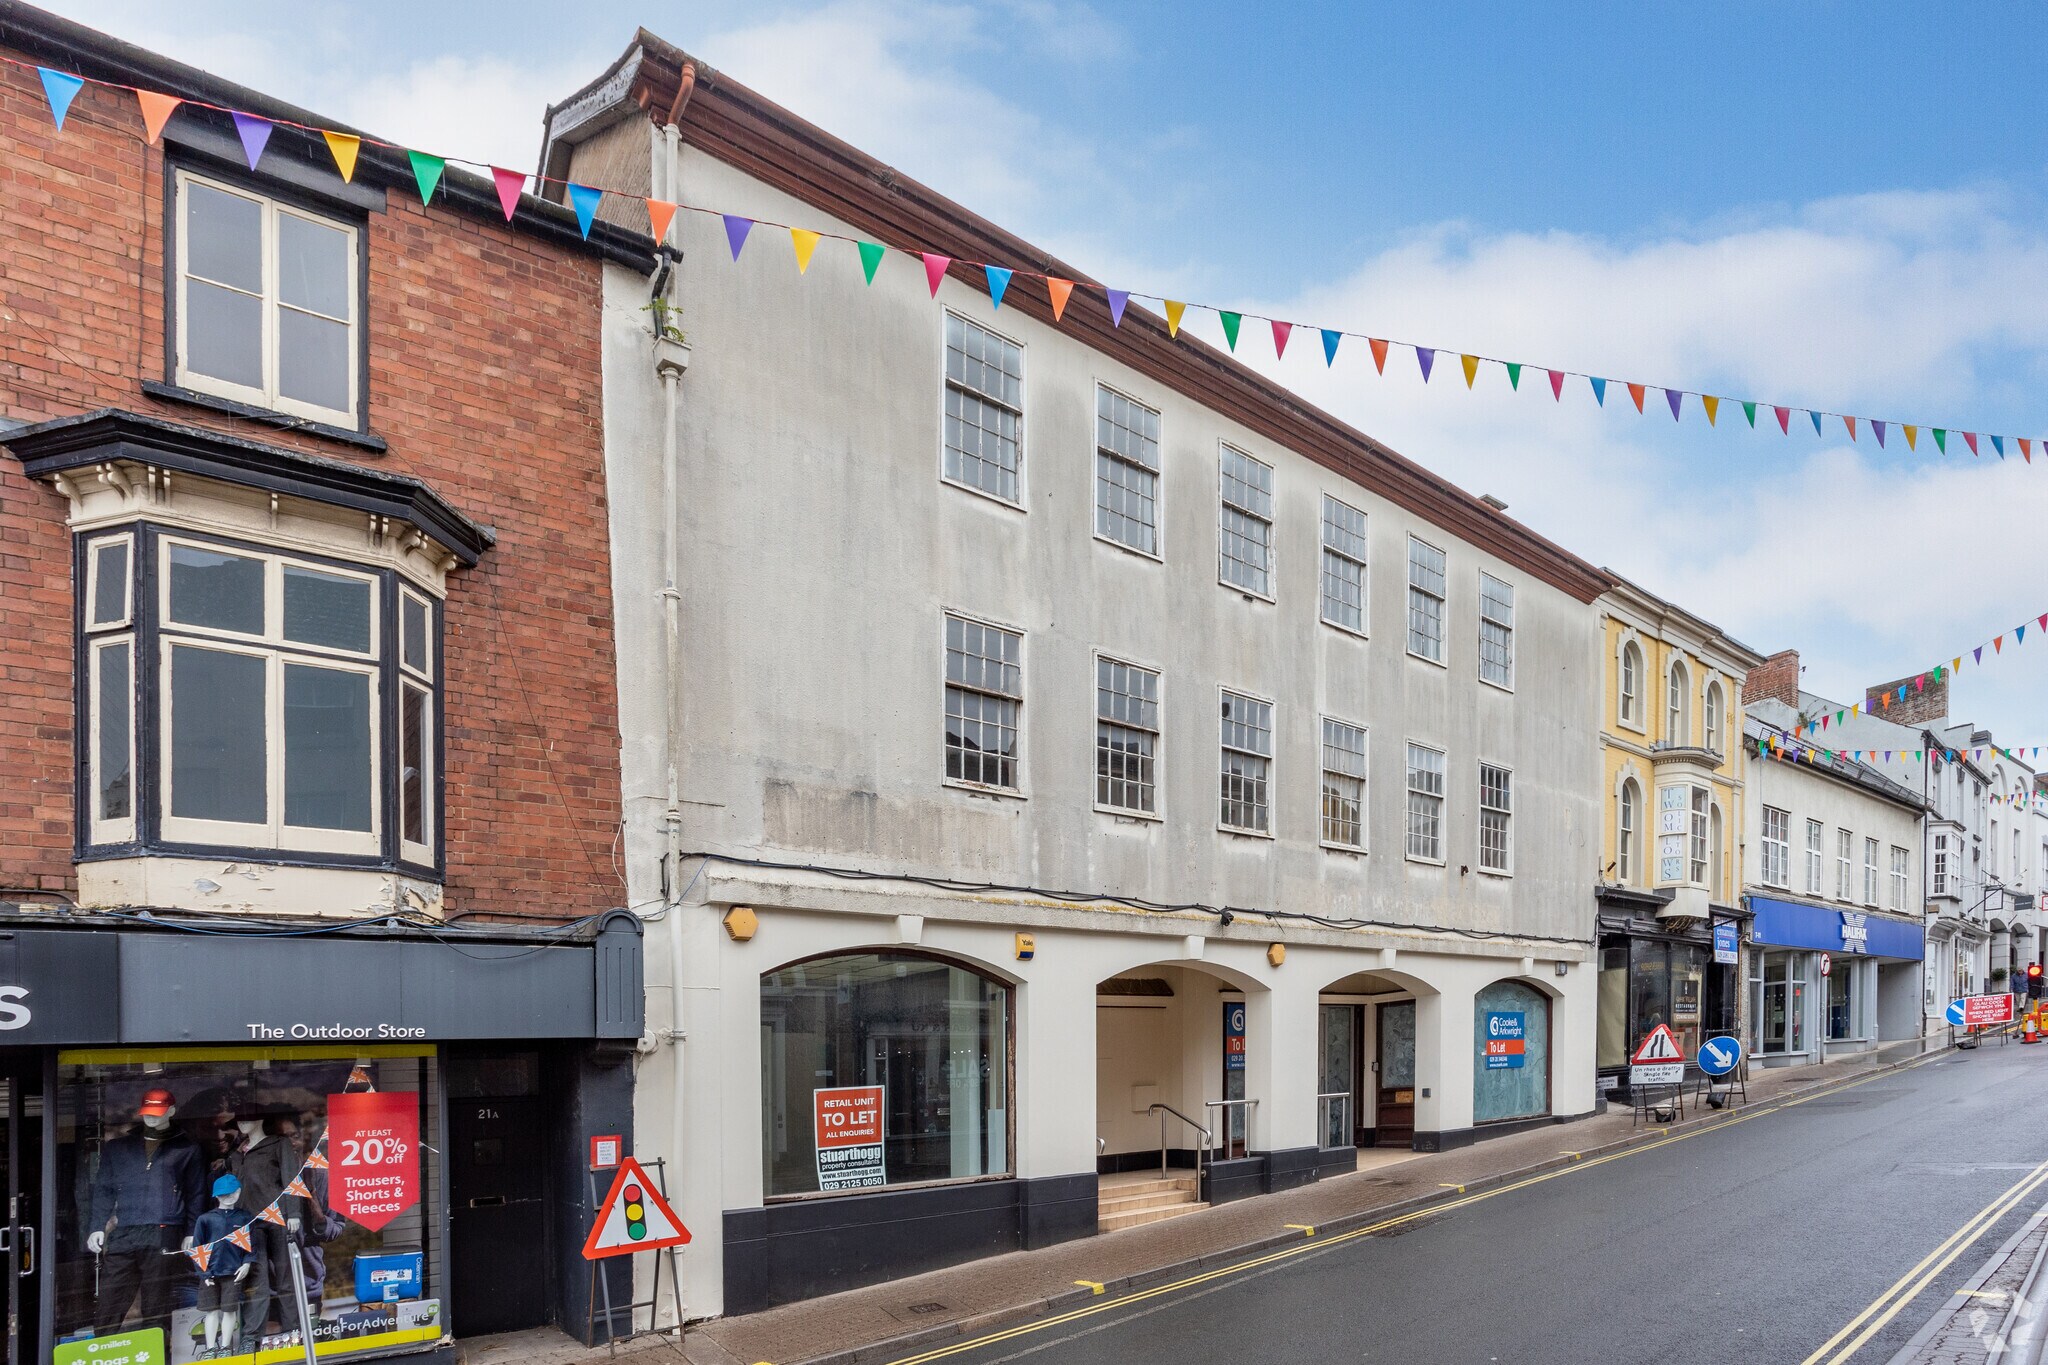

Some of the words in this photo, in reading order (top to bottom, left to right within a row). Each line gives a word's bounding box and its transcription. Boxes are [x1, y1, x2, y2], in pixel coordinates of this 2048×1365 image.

[1842, 924, 1867, 940] HALIFAX
[247, 1023, 285, 1039] The
[290, 1022, 373, 1038] Outdoor
[378, 1023, 426, 1038] Store
[1232, 1038, 1241, 1051] To
[1490, 1041, 1497, 1053] To
[1497, 1041, 1506, 1053] Let
[824, 1099, 853, 1108] RETAIL
[854, 1097, 875, 1106] UNIT
[822, 1112, 846, 1127] TO
[850, 1110, 877, 1125] LET
[355, 1130, 366, 1138] AT
[367, 1129, 392, 1137] LEAST
[840, 1128, 874, 1138] ENQUIRIES
[341, 1138, 408, 1166] 20%
[385, 1153, 404, 1164] off
[820, 1146, 881, 1163] stuarthogg
[822, 1161, 847, 1171] property
[847, 1159, 881, 1168] consultants
[822, 1167, 882, 1180] www.stuarthogg.com
[344, 1175, 405, 1188] Trousers,
[824, 1182, 840, 1190] 029
[841, 1179, 861, 1189] 2125
[862, 1177, 882, 1186] 0050
[346, 1189, 390, 1202] Shorts
[393, 1187, 404, 1198] &
[350, 1202, 401, 1215] Fleeces
[292, 1313, 429, 1342] #adeForAdventure
[100, 1339, 132, 1351] millets
